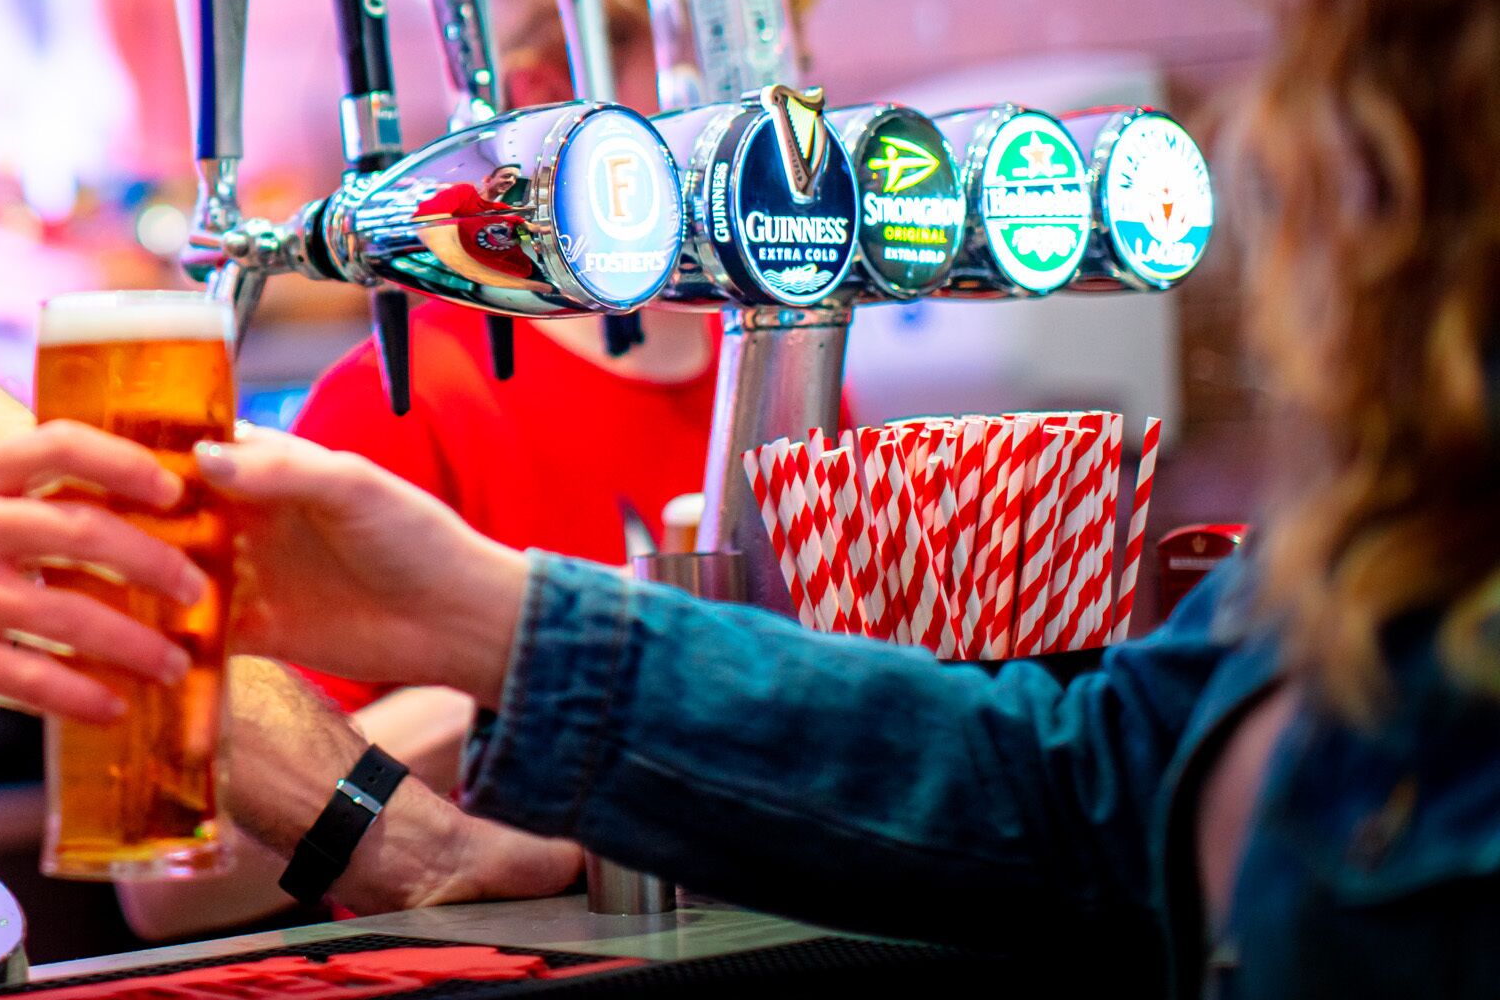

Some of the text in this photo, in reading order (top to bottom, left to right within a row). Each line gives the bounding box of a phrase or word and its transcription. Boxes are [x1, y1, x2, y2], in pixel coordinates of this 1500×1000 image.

[711, 161, 731, 243] GUINNESS
[746, 210, 849, 245] GUINNESS
[883, 225, 949, 245] ORIGINAL
[758, 247, 839, 263] EXTRA COLD
